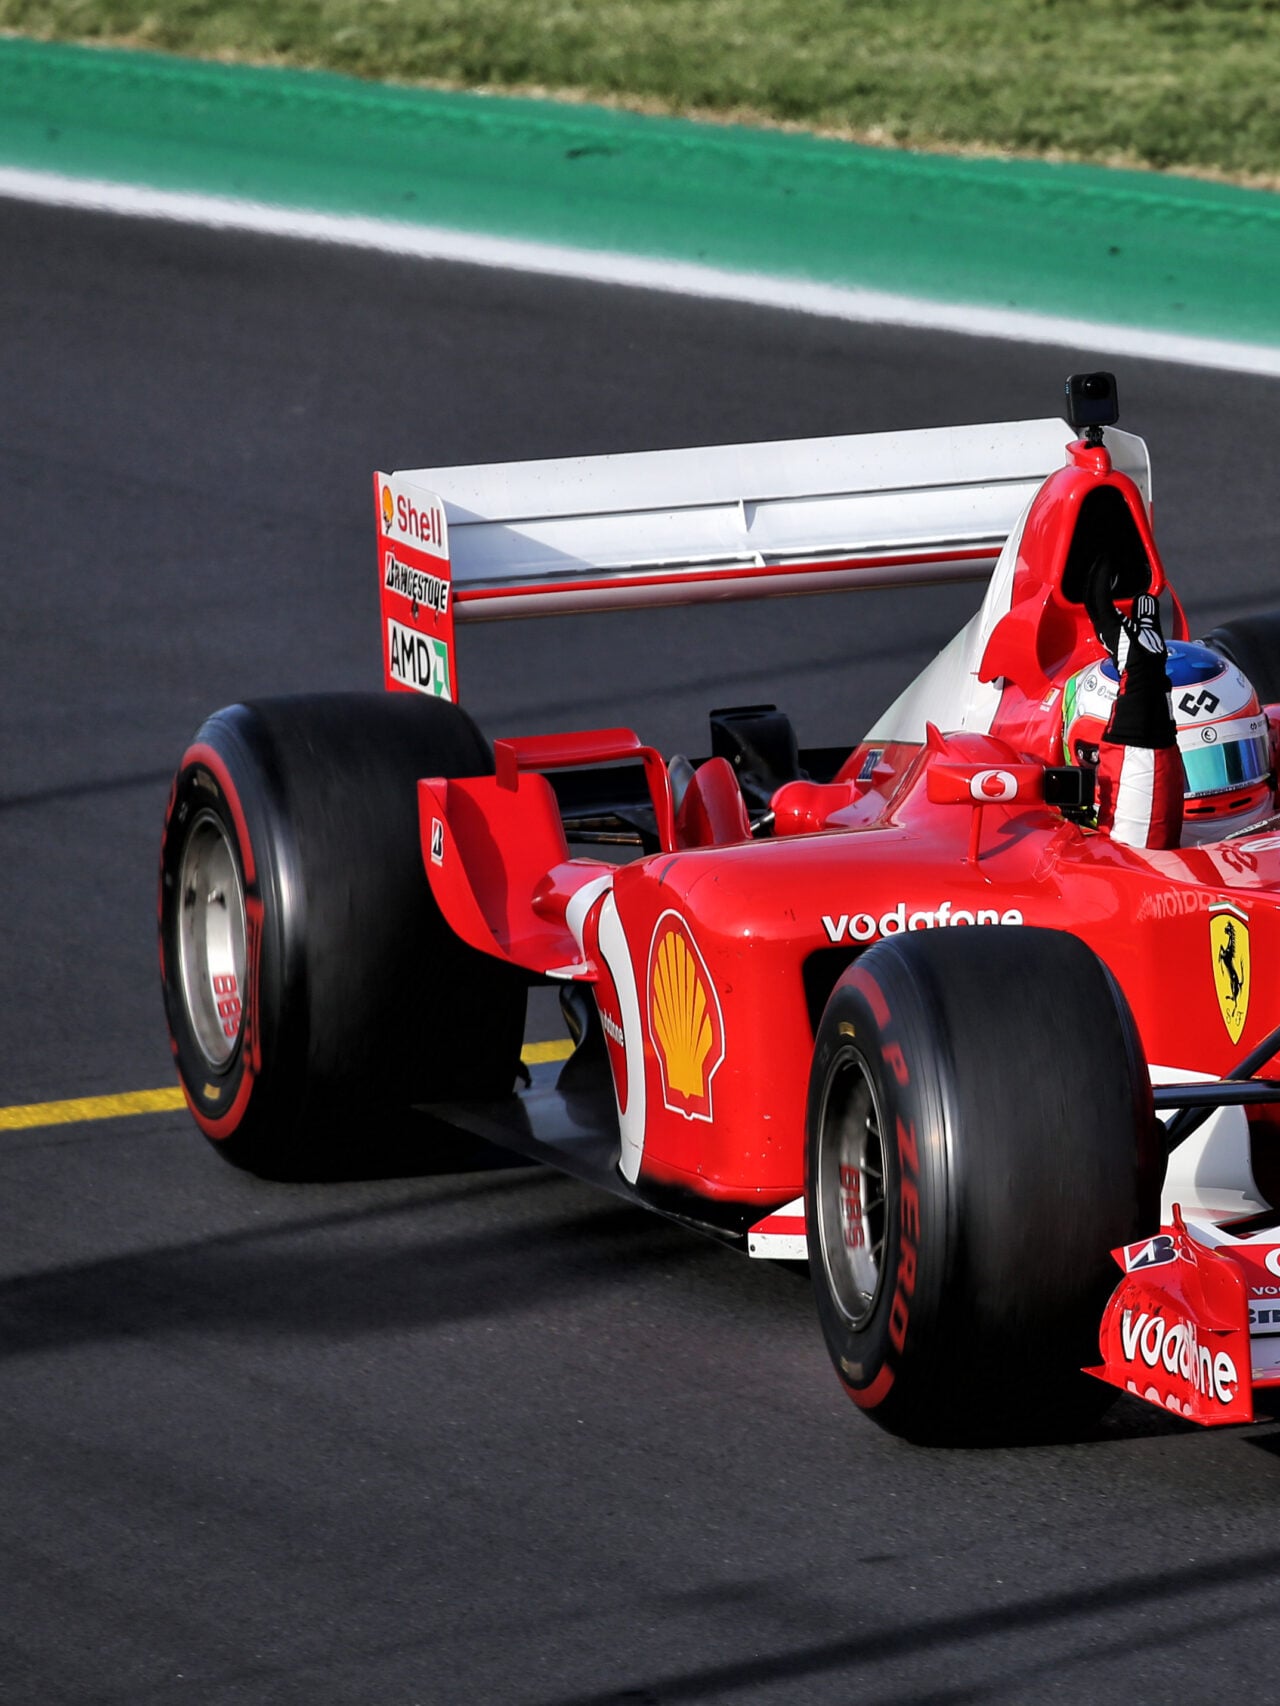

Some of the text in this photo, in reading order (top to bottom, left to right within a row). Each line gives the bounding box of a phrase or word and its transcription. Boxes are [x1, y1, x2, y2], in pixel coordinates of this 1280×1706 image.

[396, 494, 442, 547] Shell
[385, 555, 448, 611] BRIDGESTONE
[390, 626, 432, 687] AMD
[213, 974, 242, 1038] BBS
[838, 1164, 865, 1249] BBS
[889, 1113, 921, 1355] ZERO
